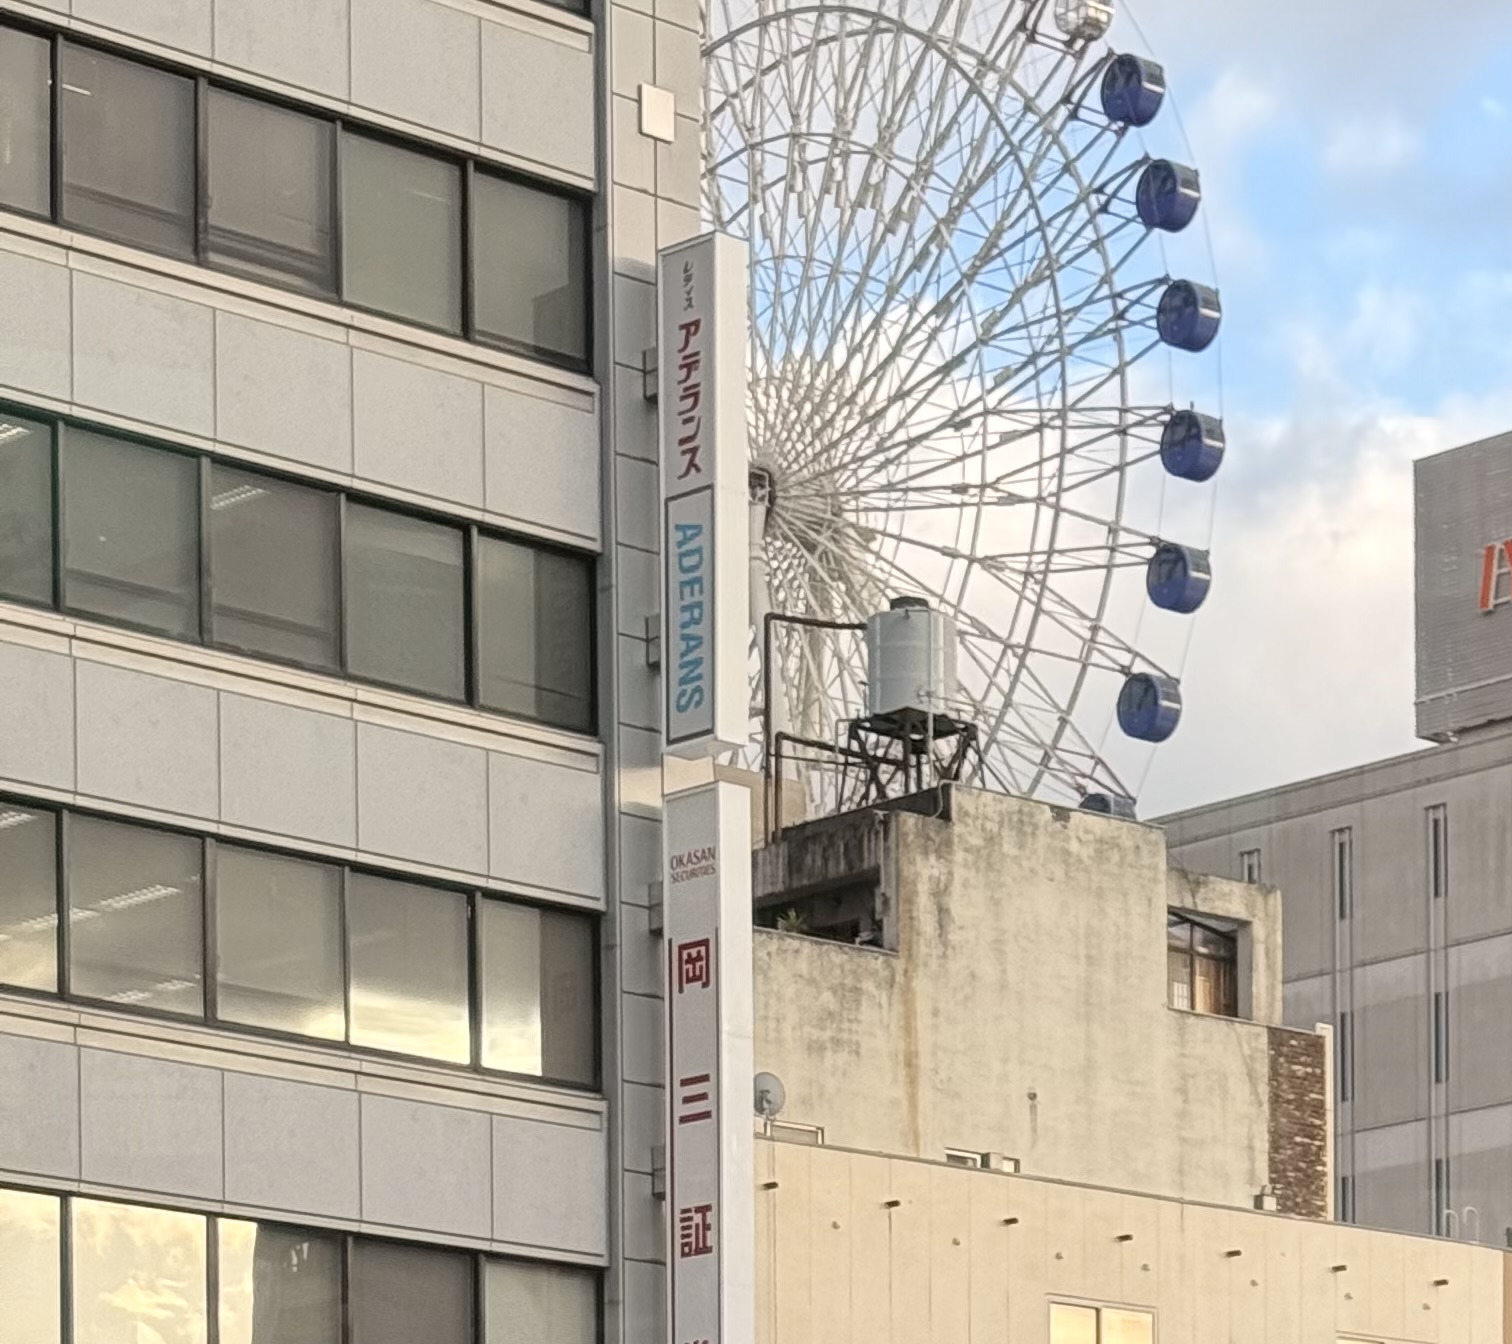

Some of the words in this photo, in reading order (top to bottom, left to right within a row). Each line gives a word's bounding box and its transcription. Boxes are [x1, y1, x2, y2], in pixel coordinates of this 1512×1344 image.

[677, 318, 702, 480] アデランス
[674, 522, 705, 715] ADERANS
[671, 846, 716, 871] OKASAN
